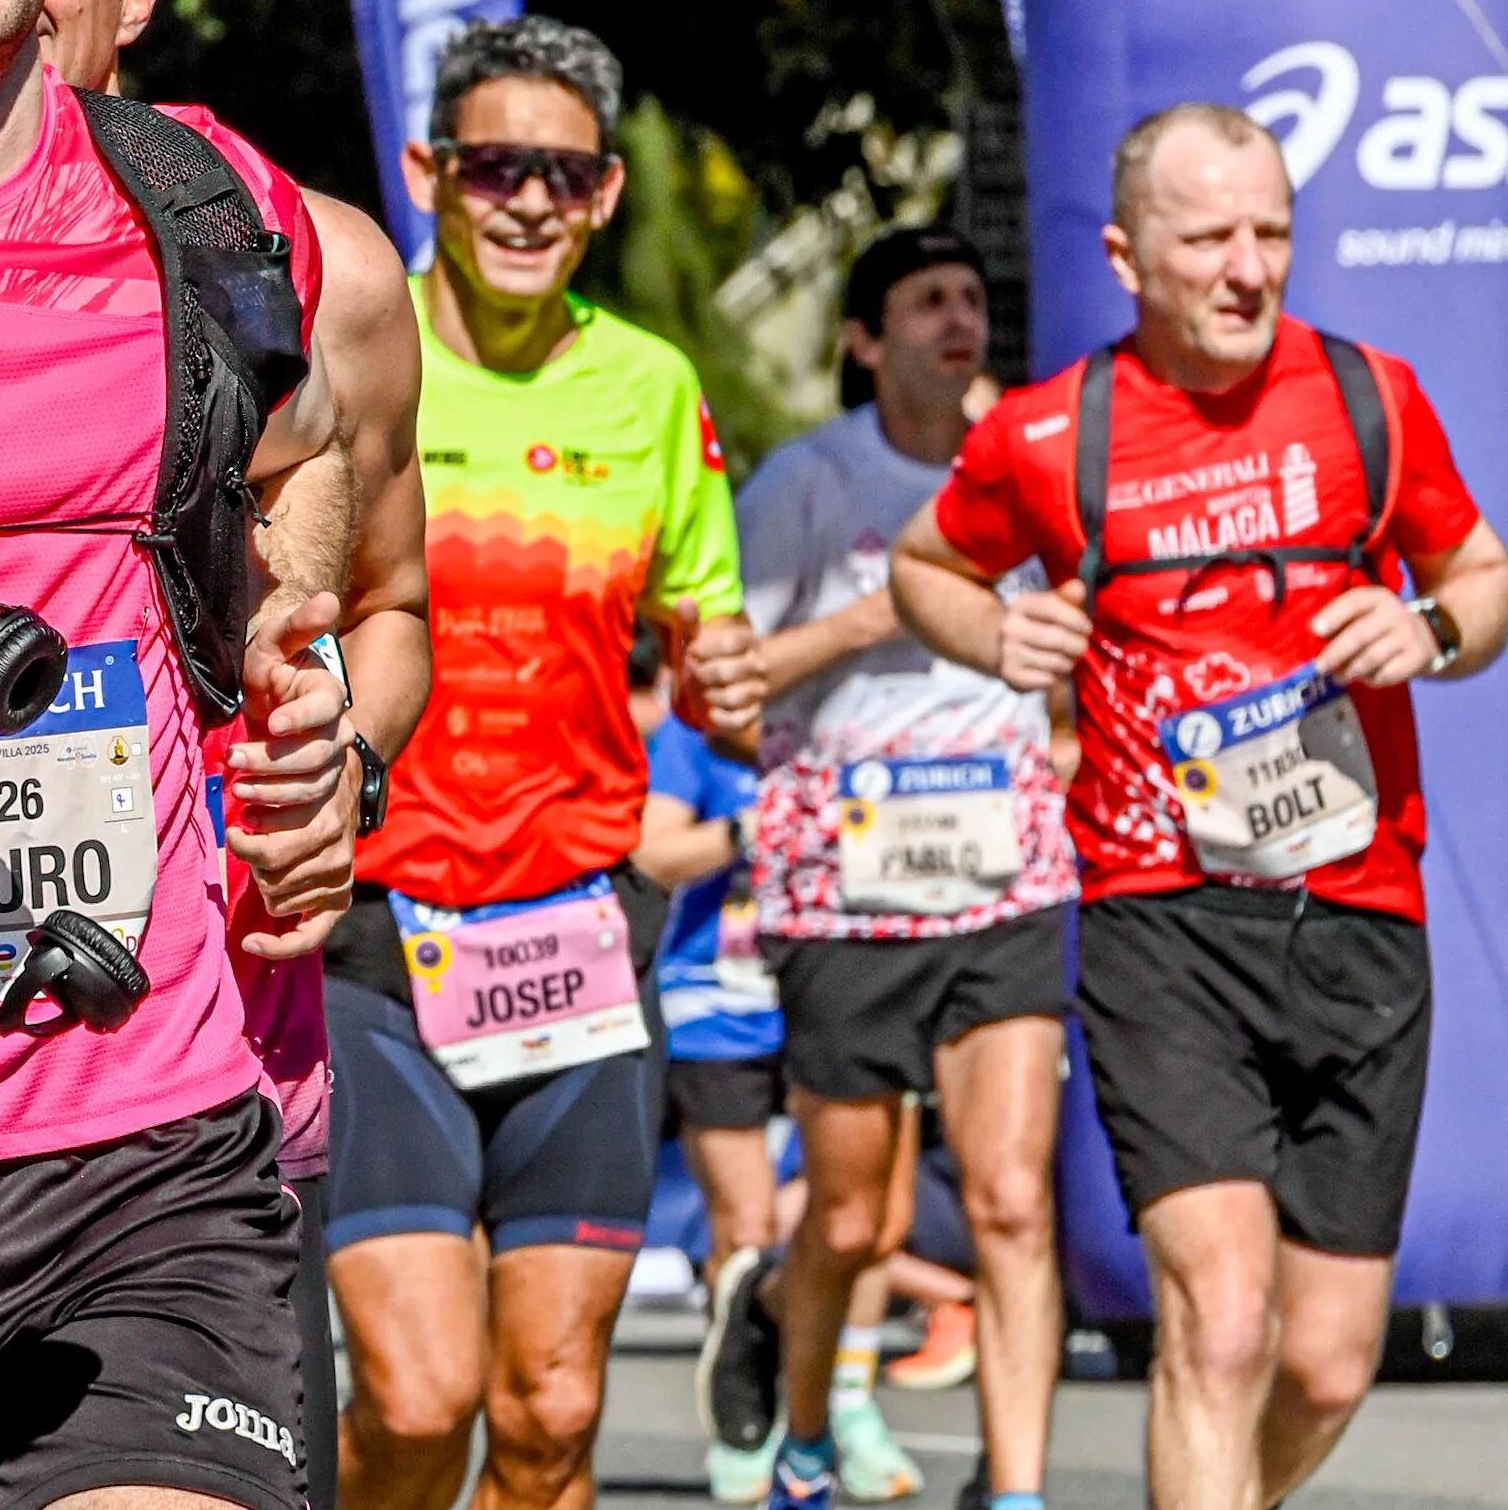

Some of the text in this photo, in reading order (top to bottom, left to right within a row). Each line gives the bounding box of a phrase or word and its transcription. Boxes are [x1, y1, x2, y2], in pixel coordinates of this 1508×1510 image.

[1335, 219, 1457, 267] sound
[1147, 502, 1280, 561] MÁLAGA
[1227, 675, 1328, 737] ZURICH
[24, 743, 50, 755] 2025
[1247, 775, 1327, 839] BOLT
[484, 933, 559, 971] 10039
[467, 970, 585, 1029] JOSEP
